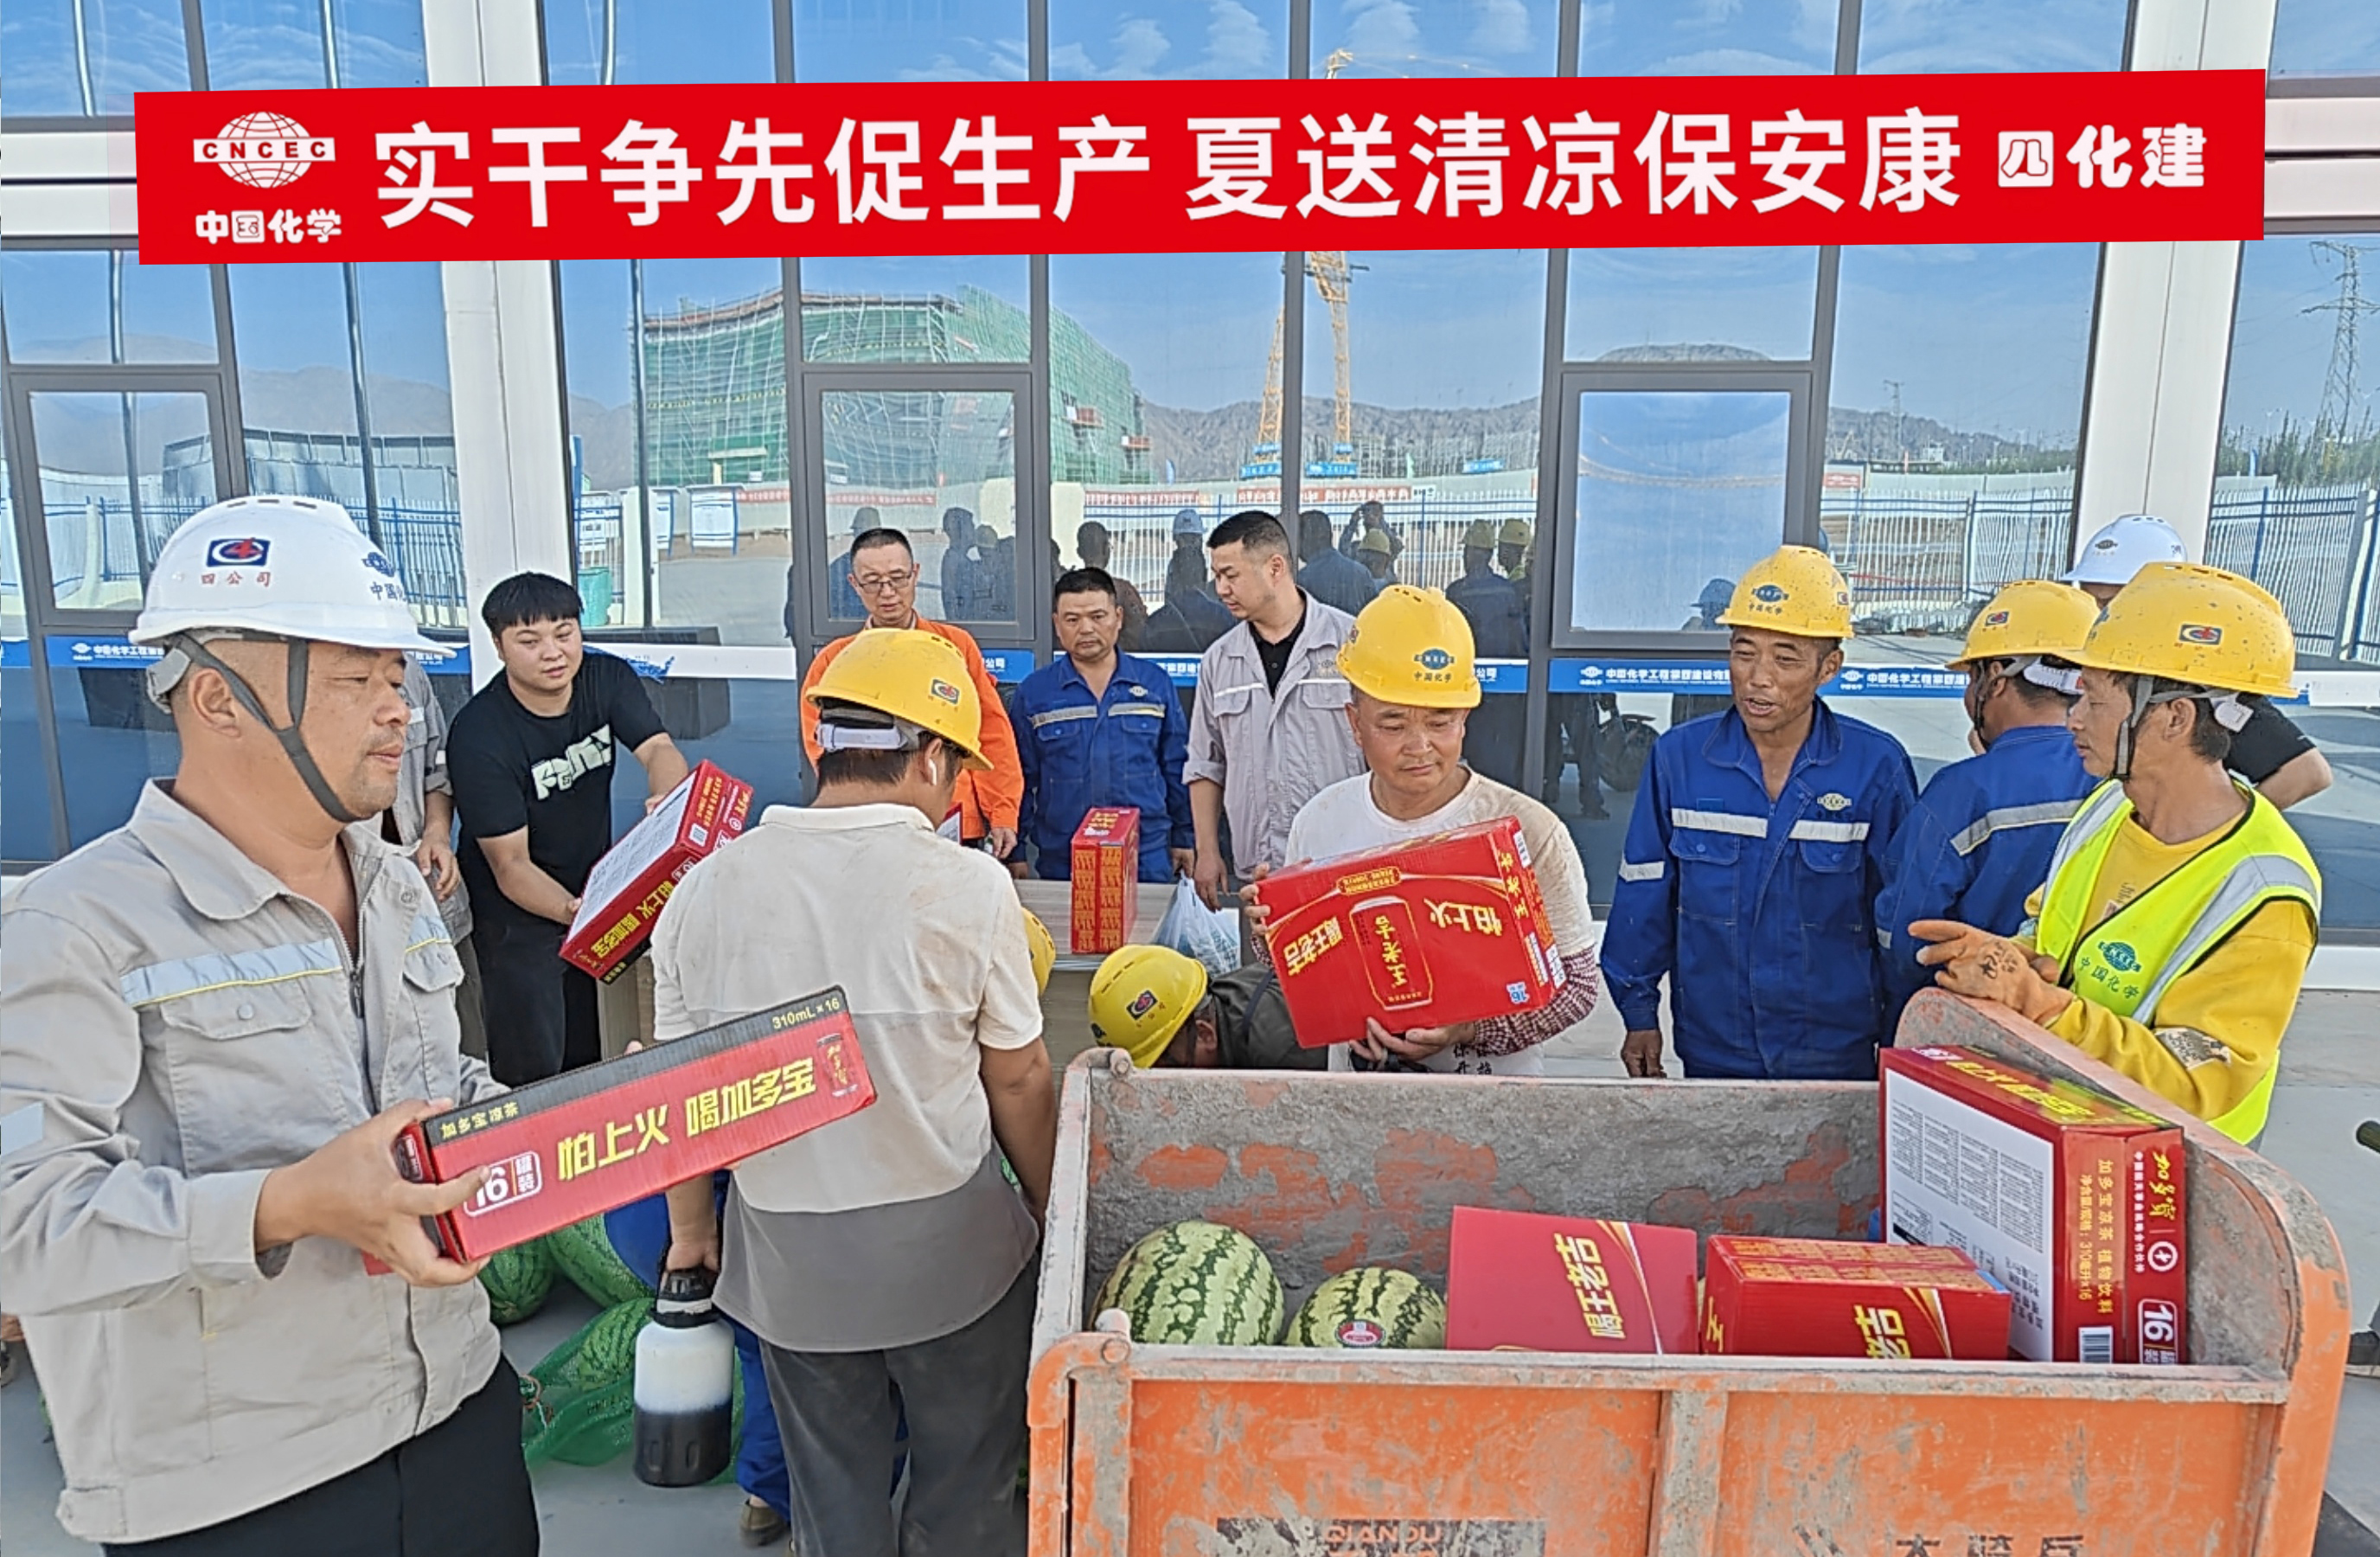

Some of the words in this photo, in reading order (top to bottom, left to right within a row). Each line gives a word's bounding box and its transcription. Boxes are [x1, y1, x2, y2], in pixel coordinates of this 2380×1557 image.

[202, 141, 326, 159] CNCEC
[375, 114, 1149, 228] 实干争先促生产
[1187, 106, 1960, 220] 夏送清凉保安康
[1999, 124, 2206, 188] 四化建
[196, 208, 342, 244] 中国化学
[1283, 914, 1343, 977] 喝王老吉
[1423, 897, 1504, 938] 怕上火
[1374, 913, 1409, 988] 王老吉
[2079, 957, 2140, 999] 中国化学
[440, 1101, 519, 1139] 加多宝凉茶
[556, 1105, 670, 1182] 怕上火
[684, 1057, 817, 1137] 喝加多宝
[2097, 1158, 2114, 1241] 加多宝凉茶
[1553, 1232, 1626, 1340] 喝王老吉
[2144, 1304, 2173, 1342] 16
